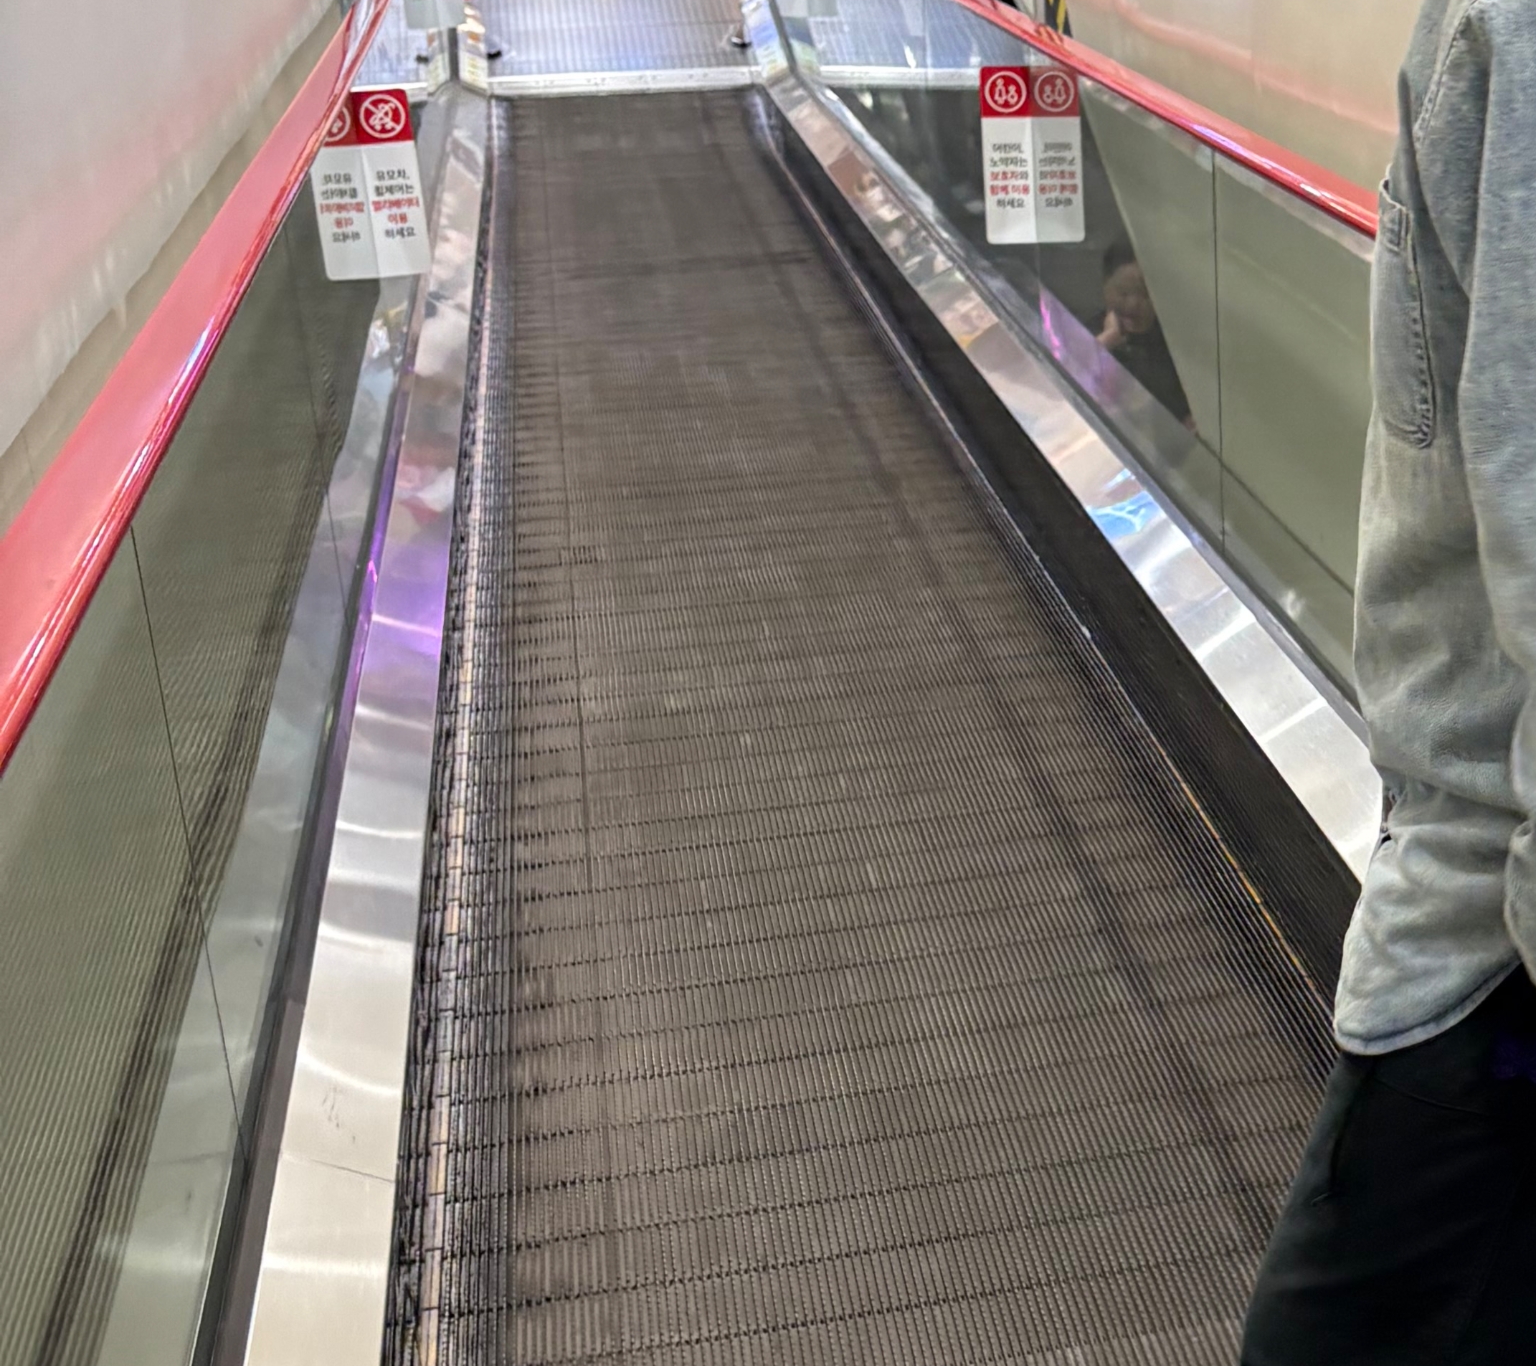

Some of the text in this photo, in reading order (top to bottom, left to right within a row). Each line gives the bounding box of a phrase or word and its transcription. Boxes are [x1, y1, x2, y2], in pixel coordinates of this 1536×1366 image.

[989, 156, 1028, 168] 노약자는
[374, 183, 414, 197] 휠체어는
[1011, 184, 1030, 196] 이용
[371, 196, 420, 212] 엘리베이터
[996, 197, 1025, 209] 하세요
[387, 212, 408, 225] 이용
[385, 226, 416, 239] 하세요
